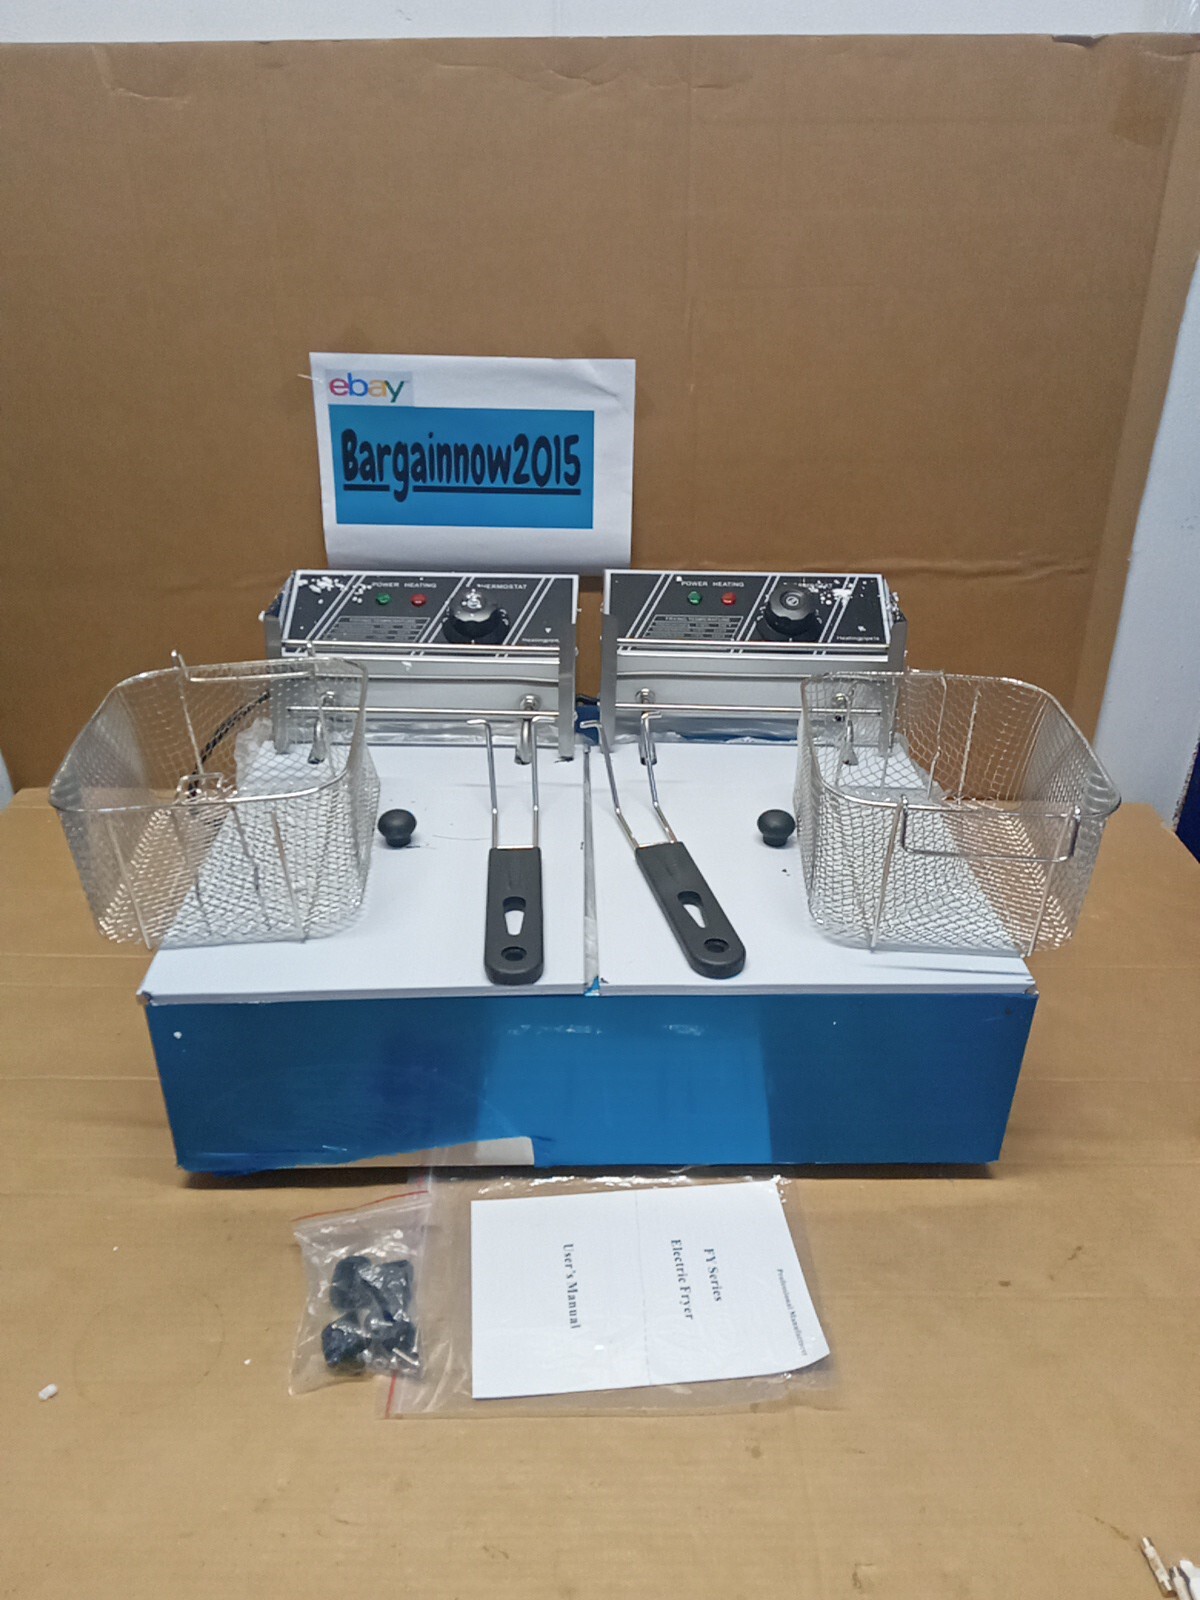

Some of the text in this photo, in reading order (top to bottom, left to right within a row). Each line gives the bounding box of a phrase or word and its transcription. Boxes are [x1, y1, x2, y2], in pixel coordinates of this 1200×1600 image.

[329, 372, 404, 403] ebay
[341, 428, 581, 502] Bargainnow2015
[562, 1243, 581, 1329] User's Manual
[671, 1238, 694, 1320] Electric Fryer
[704, 1248, 724, 1302] FY Series
